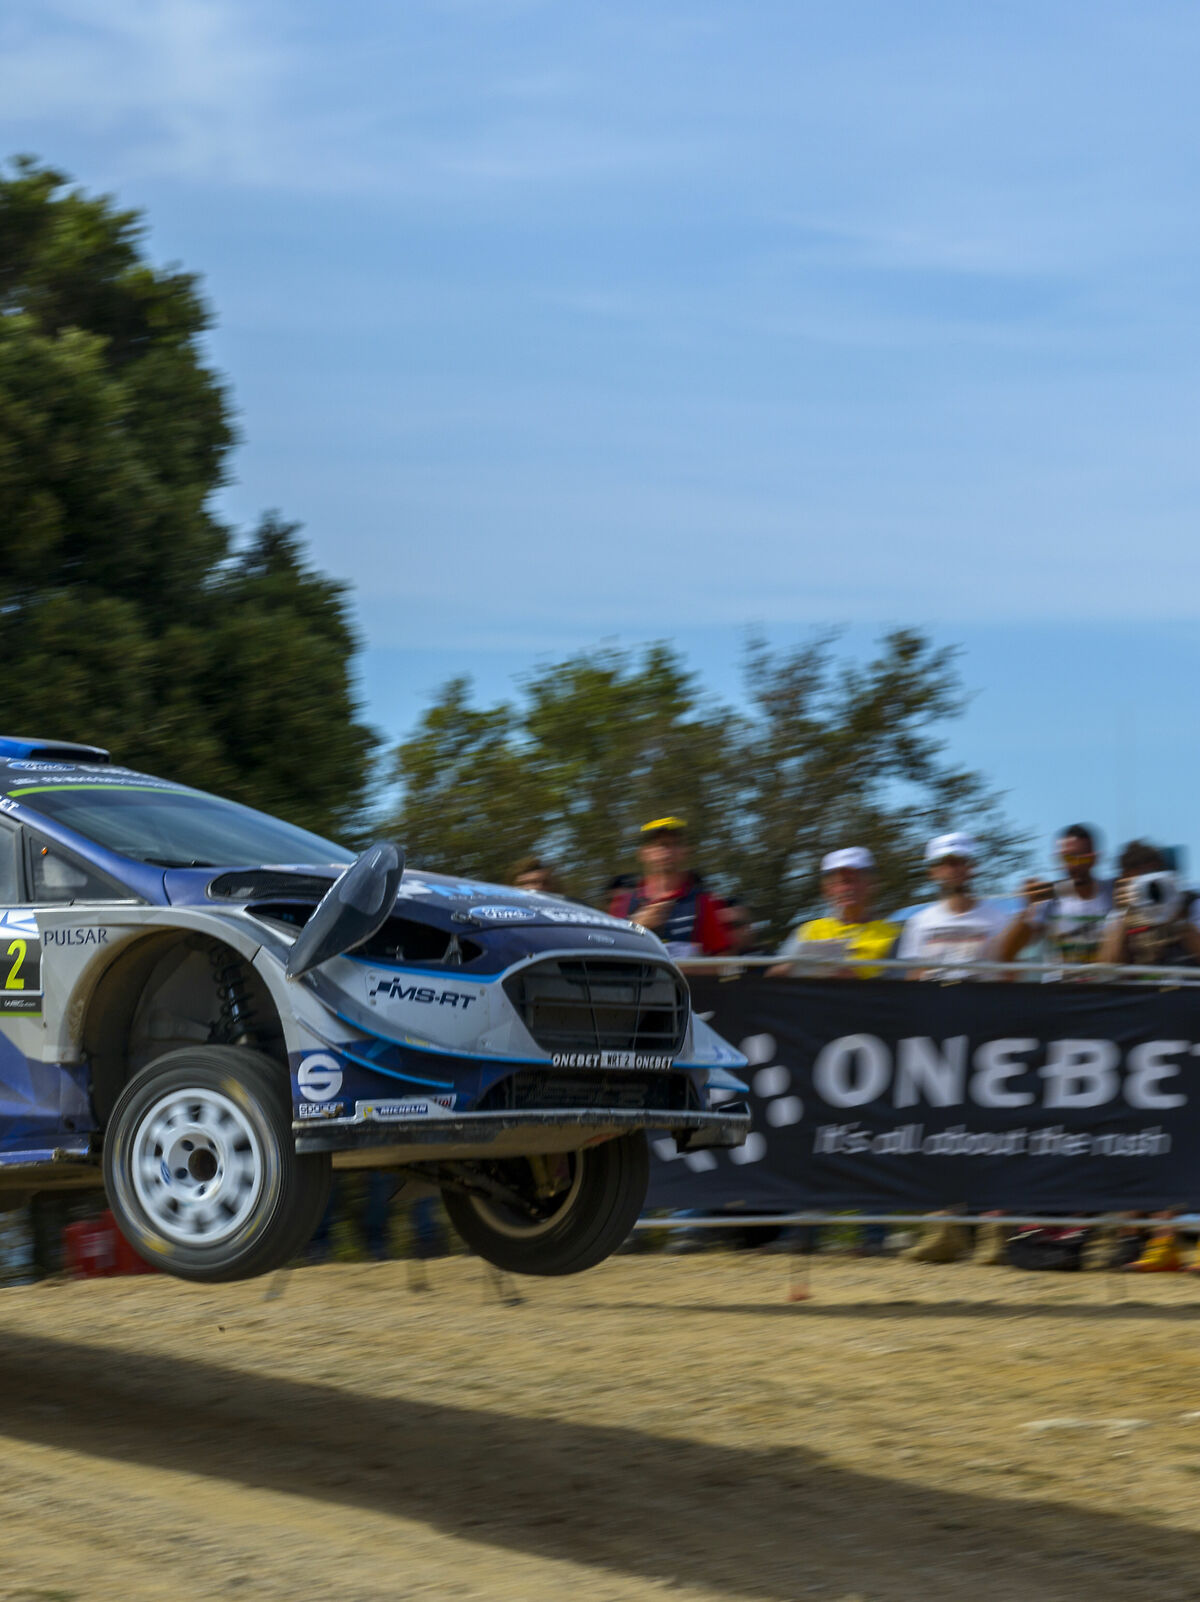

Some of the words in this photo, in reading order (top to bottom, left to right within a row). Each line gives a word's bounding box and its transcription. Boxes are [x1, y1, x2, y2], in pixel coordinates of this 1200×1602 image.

[44, 928, 109, 947] PULSAR
[4, 938, 28, 991] 2
[552, 1053, 600, 1068] ONEBET
[812, 1033, 1200, 1110] ONEBE
[380, 1104, 428, 1115] MICHELIN
